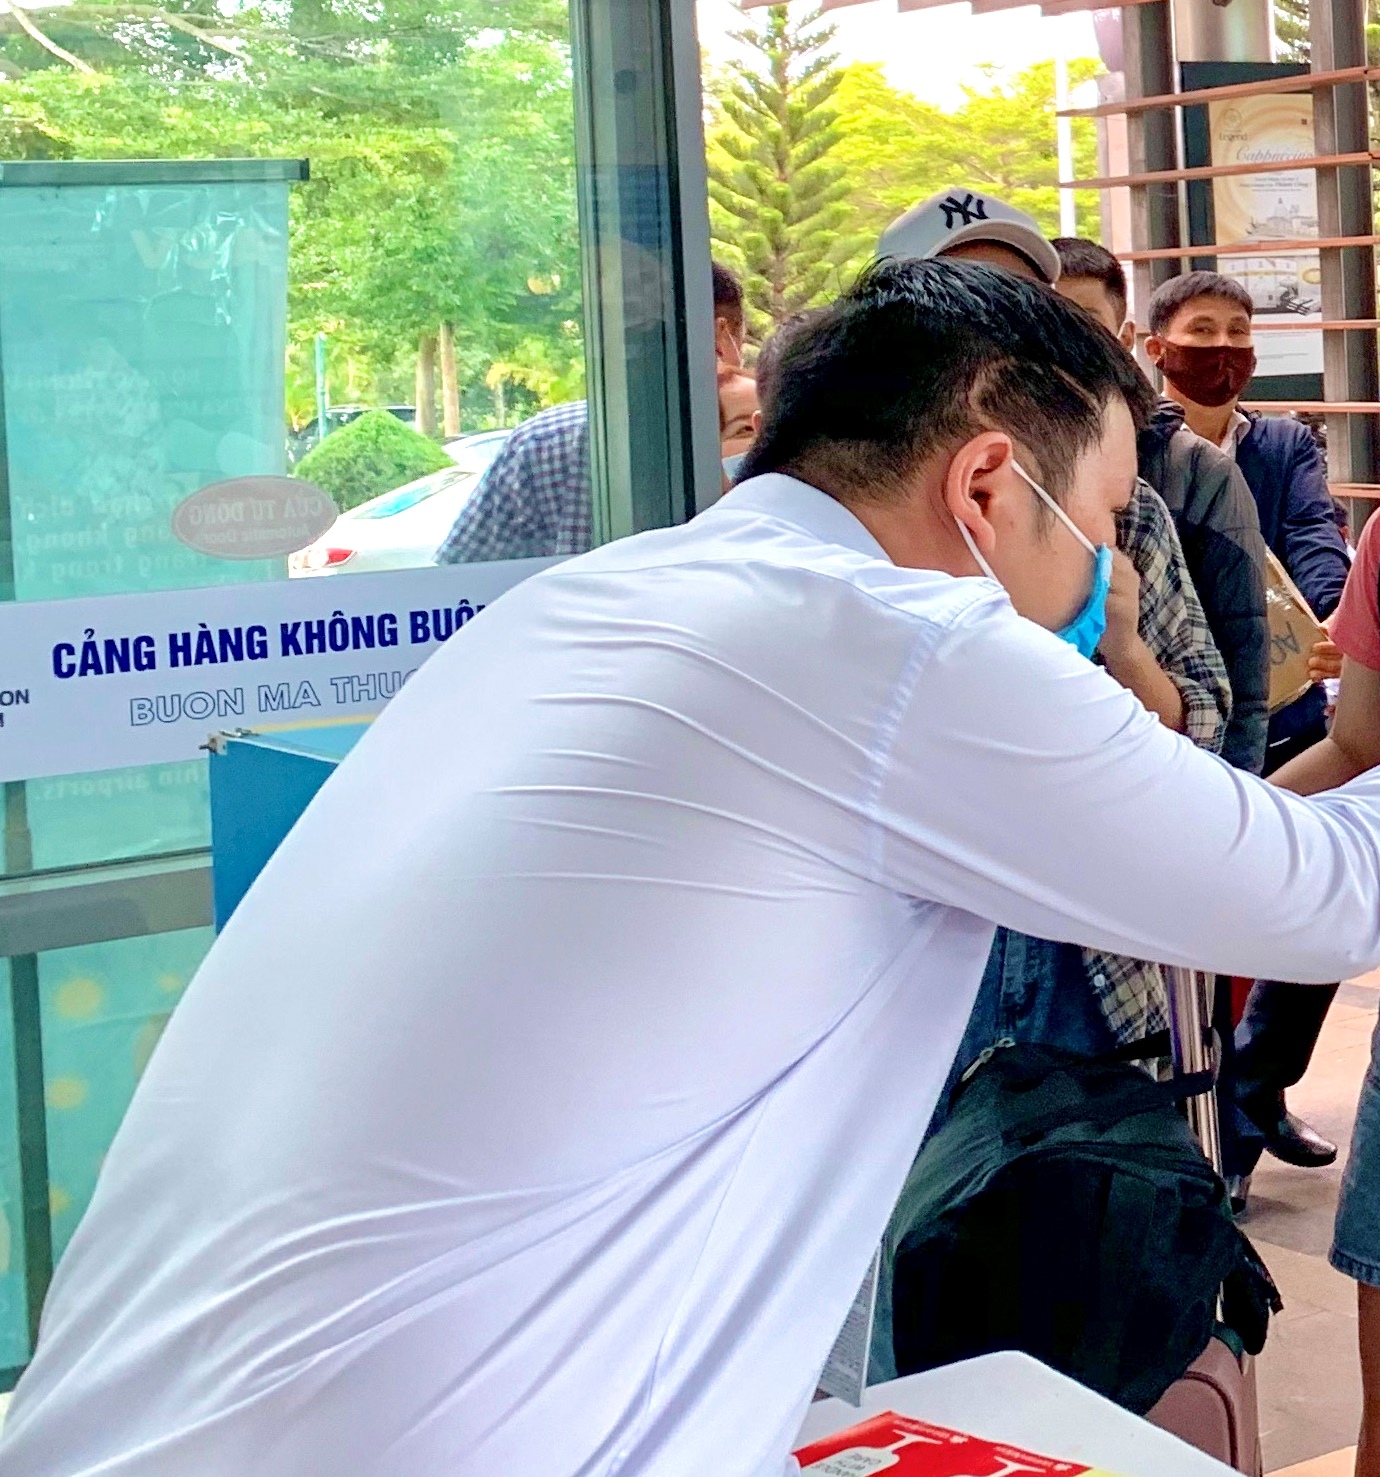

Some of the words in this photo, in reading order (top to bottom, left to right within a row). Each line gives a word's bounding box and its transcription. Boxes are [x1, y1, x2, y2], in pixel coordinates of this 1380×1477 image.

[938, 193, 991, 229] NY
[52, 628, 156, 679] CẢNG
[169, 622, 268, 668] HÀNG
[281, 610, 398, 657] KHÔNG
[410, 599, 485, 644] BUÔ
[130, 686, 245, 726] BUON
[258, 680, 321, 713] MA
